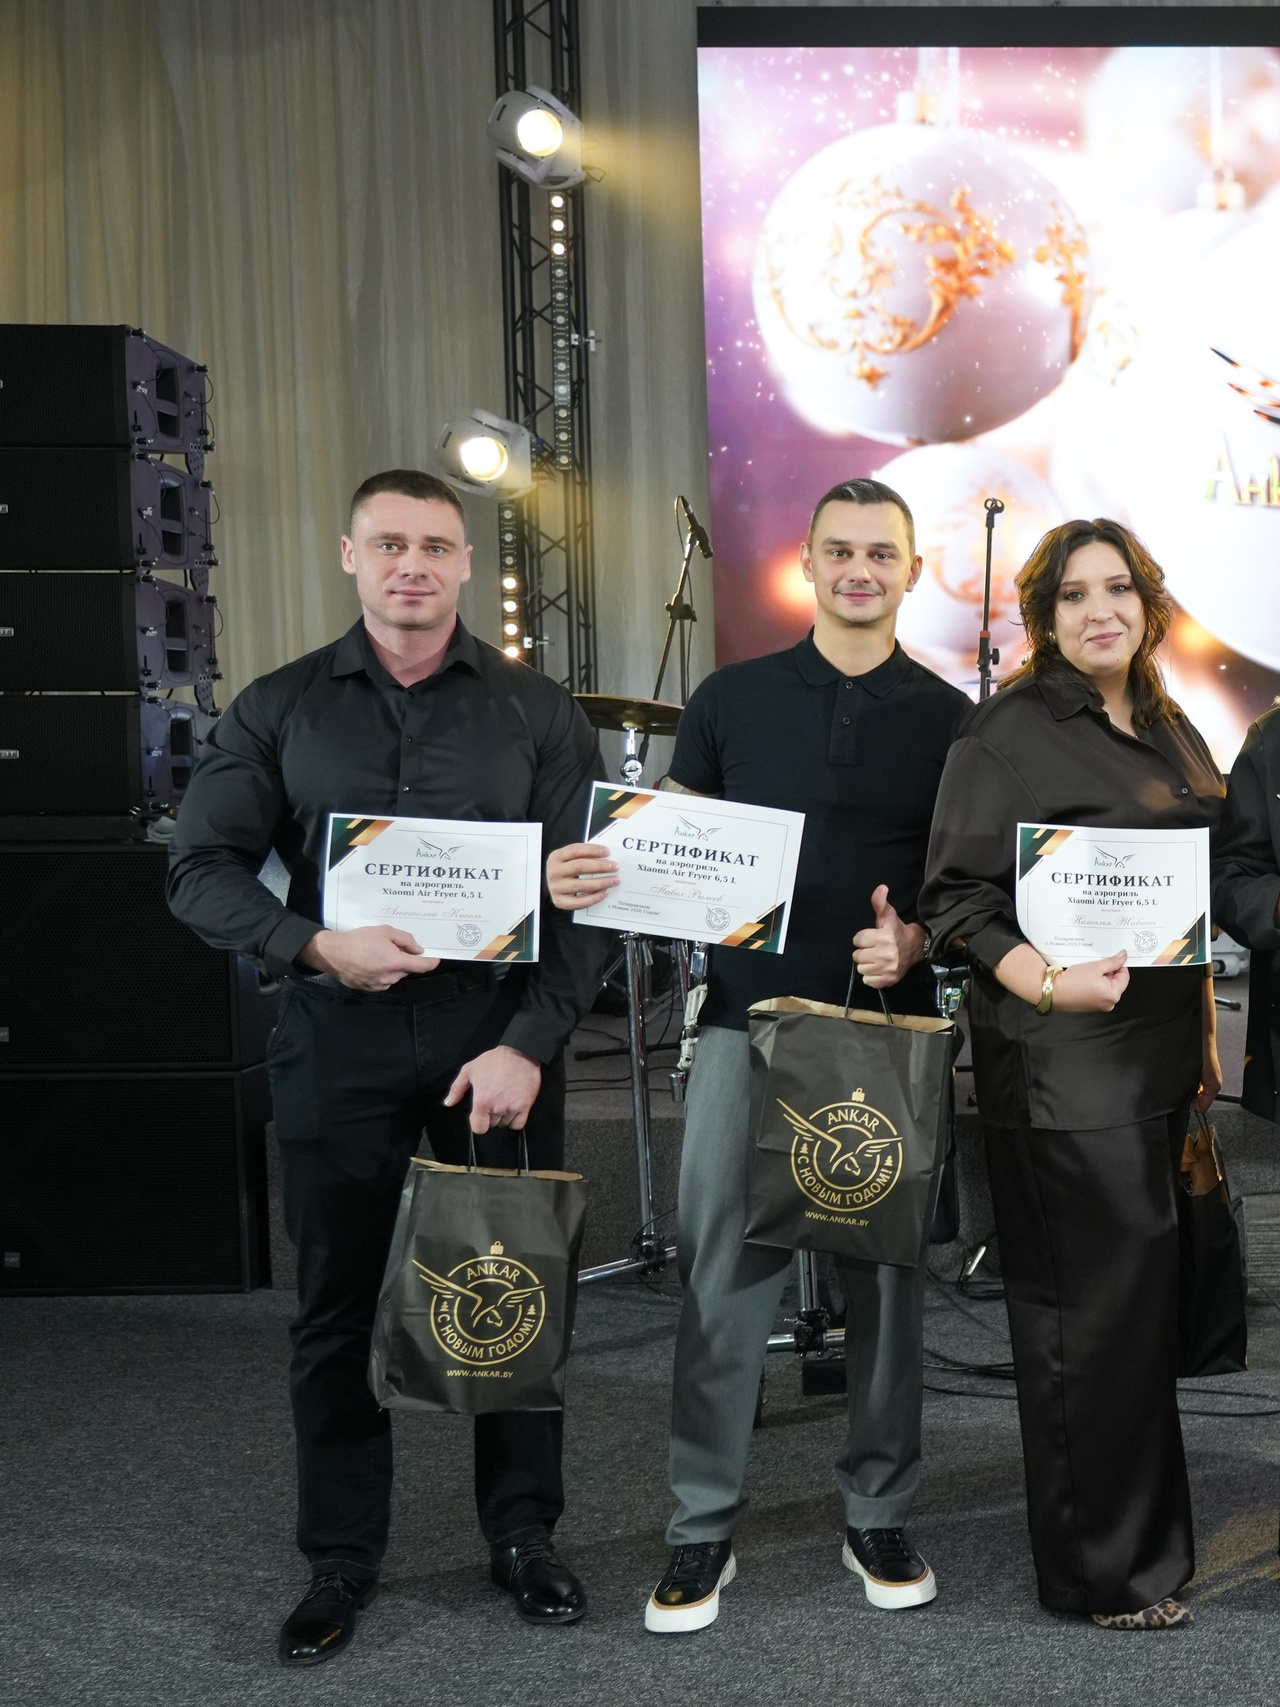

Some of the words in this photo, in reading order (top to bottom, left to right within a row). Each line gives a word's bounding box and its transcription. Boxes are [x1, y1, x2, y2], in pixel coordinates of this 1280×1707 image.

[622, 837, 759, 867] СЕРТИФИКАТ
[365, 863, 503, 880] СЕРТИФИКАТ
[670, 860, 718, 872] аэрогриль
[637, 864, 669, 875] Xiaomi
[672, 869, 685, 877] Air
[688, 871, 711, 881] Fryer
[714, 875, 728, 883] 6,5
[731, 877, 737, 885] L
[1051, 872, 1174, 887] СЕРТИФИКАТ
[383, 888, 415, 896] Xiaomi
[435, 890, 458, 899] Fryer
[461, 891, 475, 899] 6,5
[1094, 890, 1138, 898] аэрогриль
[1068, 897, 1095, 905] Xiaomi
[1112, 899, 1133, 907] Fryer
[1136, 899, 1149, 907] 6,5
[828, 1109, 879, 1132] ANKAR
[797, 1155, 809, 1165] С
[799, 1167, 841, 1205] НОВЫМ
[846, 1168, 892, 1205] ГОДОМ!
[805, 1211, 870, 1227] WWW.ANKAR.BY
[466, 1263, 520, 1282] ANKAR
[438, 1315, 449, 1323] С
[440, 1324, 484, 1358] НОВЫМ
[489, 1318, 536, 1358] ГОДОМ!
[447, 1370, 513, 1378] WWW.ANKAR.BY
